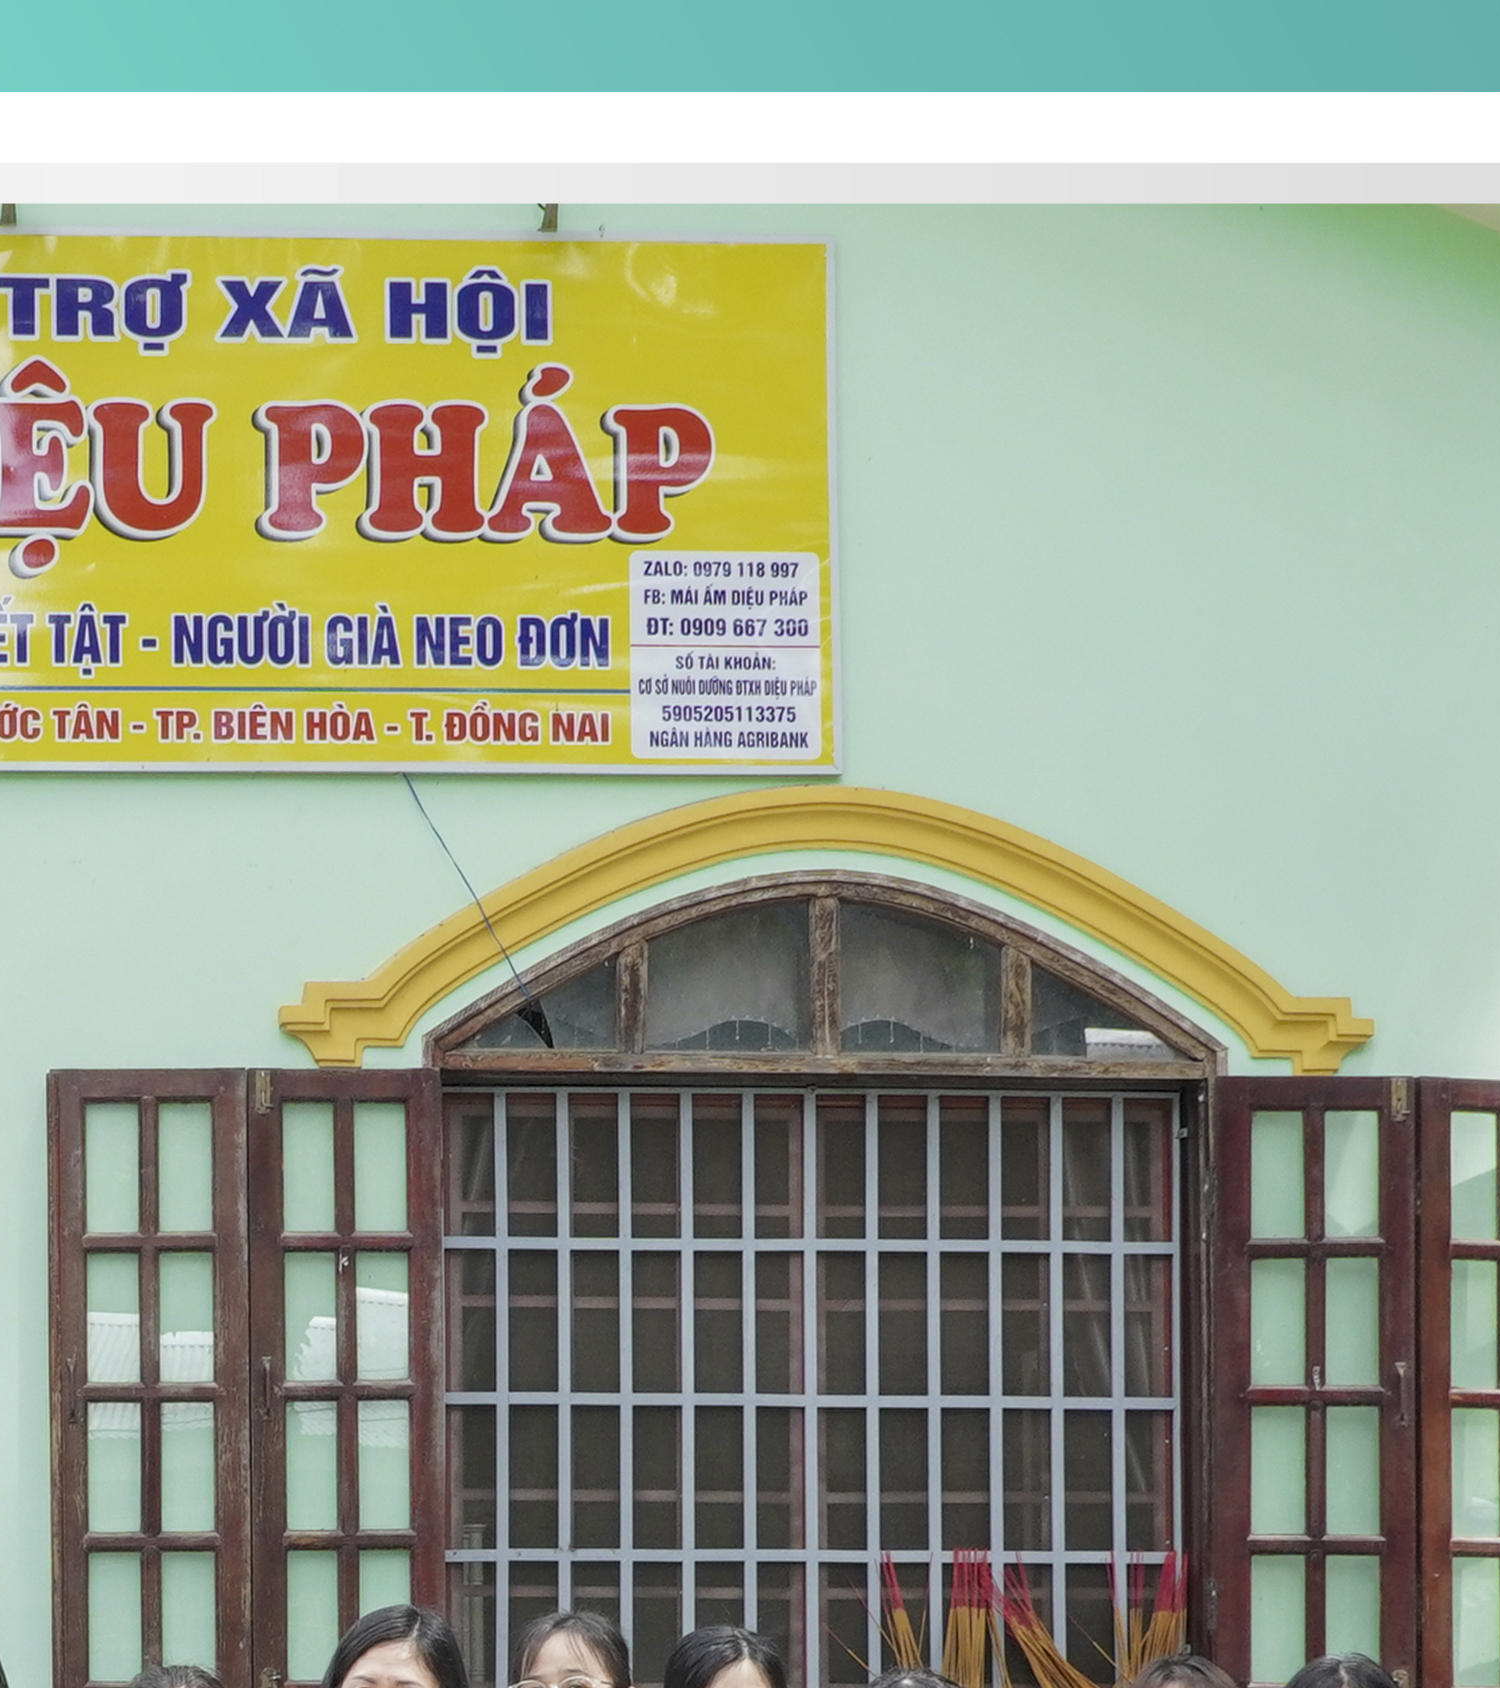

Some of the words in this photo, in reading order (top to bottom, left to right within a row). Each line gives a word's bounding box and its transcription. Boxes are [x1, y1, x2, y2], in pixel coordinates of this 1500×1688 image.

[218, 267, 355, 342] XÃ
[387, 267, 550, 354] HỘI
[254, 364, 715, 543] PHÁP
[644, 561, 688, 577] ZALO:
[693, 561, 731, 577] 0979
[738, 562, 765, 578] 118
[771, 563, 798, 578] 997
[644, 589, 665, 605] FB:
[671, 586, 698, 605] MÁI
[704, 584, 726, 605] ẤM
[731, 586, 764, 609] DIỆU
[769, 587, 807, 606] PHÁP
[647, 617, 673, 636] ĐT:
[680, 618, 726, 636] 0909
[733, 619, 767, 636] 667
[774, 619, 808, 637] 300
[48, 603, 126, 676] TẬT
[173, 602, 310, 667] NGƯỜI
[326, 605, 401, 667] GIÀ
[414, 616, 504, 667] NEO
[518, 611, 610, 668] ĐƠN
[675, 651, 693, 669] SỐ
[698, 653, 719, 669] TÀI
[725, 652, 776, 670] KHOẢN:
[53, 704, 120, 740] TÂN
[156, 710, 201, 742] TP.
[213, 703, 295, 742] BIÊN
[306, 703, 375, 742] HÒA
[410, 711, 434, 743] T.
[445, 701, 538, 743] ĐỒNG
[551, 712, 610, 743] NAI
[662, 705, 796, 722] 5905205113375
[650, 728, 689, 747] NGÂN
[694, 728, 732, 748] HÀNG
[737, 732, 809, 748] AGRIBANK
